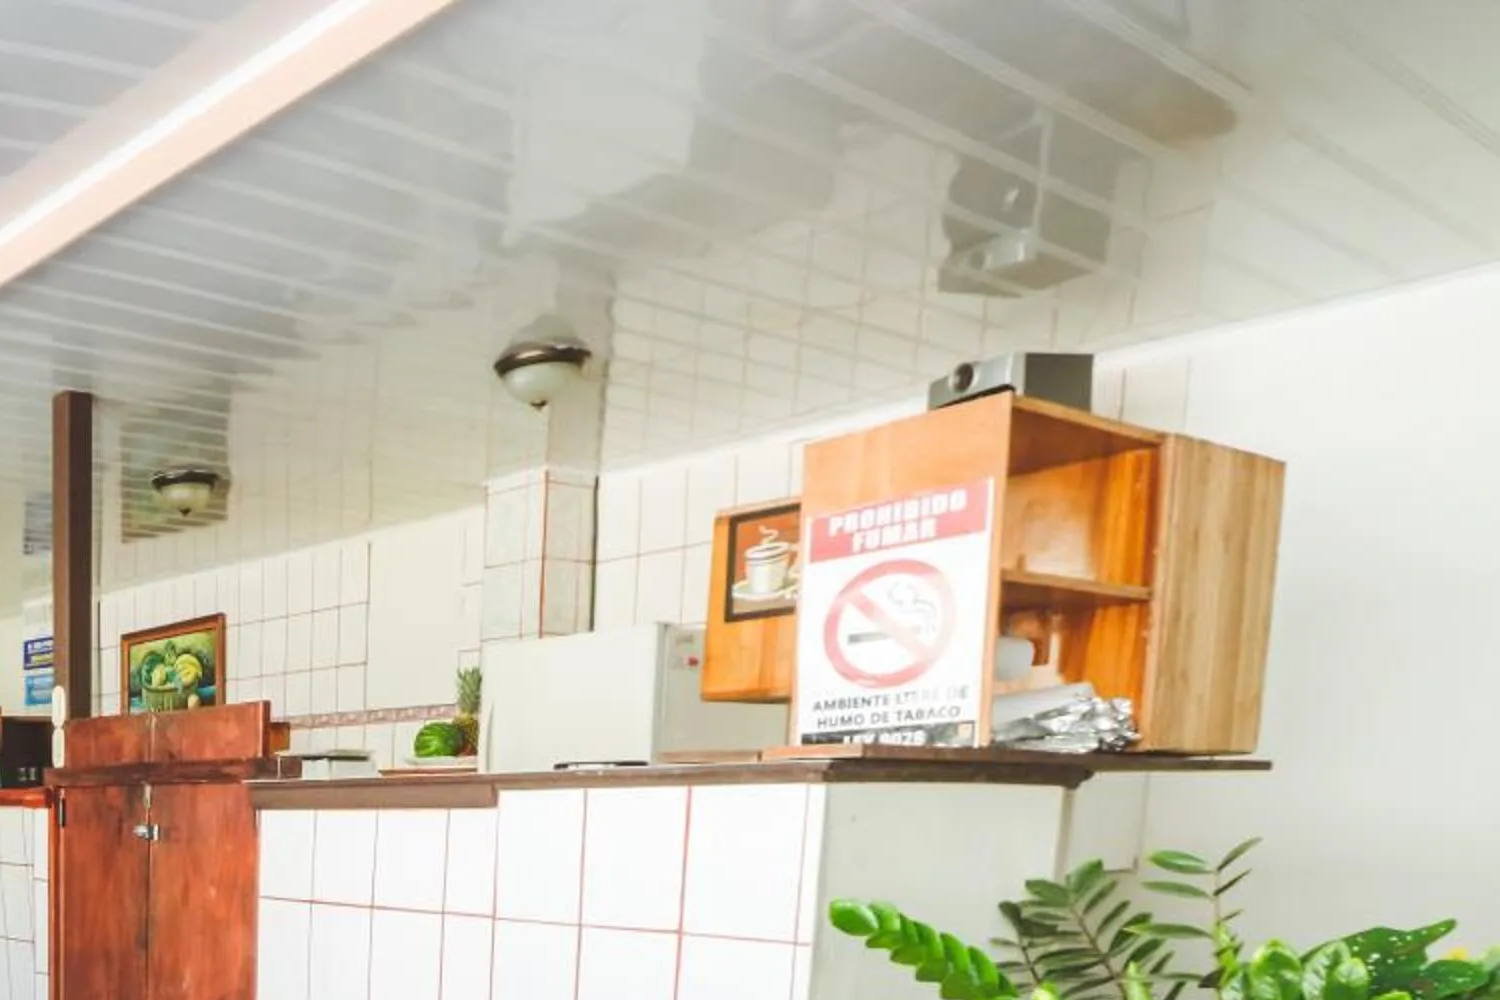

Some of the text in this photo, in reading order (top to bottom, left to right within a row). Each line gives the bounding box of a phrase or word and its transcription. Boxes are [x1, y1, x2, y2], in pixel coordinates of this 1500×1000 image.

[829, 490, 967, 536] PROHIBIDO
[853, 518, 936, 552] FUMAR
[813, 695, 889, 711] AMBIENTE
[817, 705, 962, 729] HUMO DE TABACO
